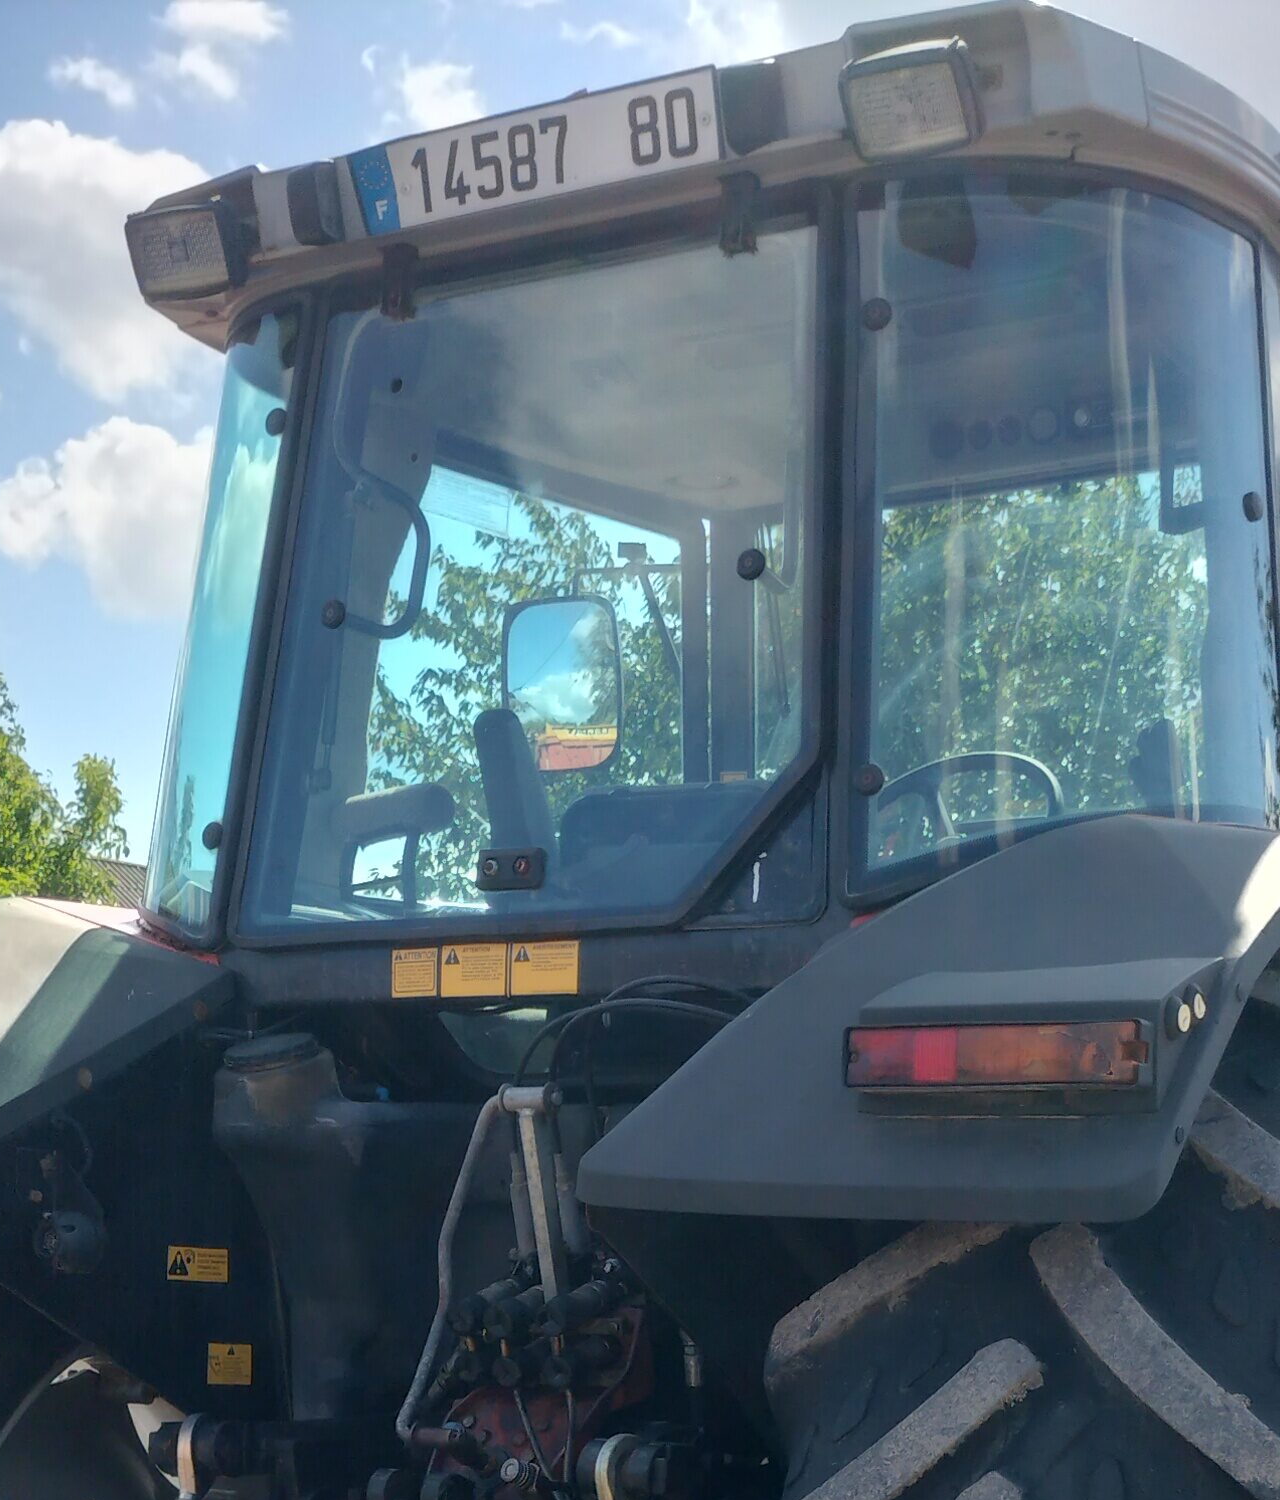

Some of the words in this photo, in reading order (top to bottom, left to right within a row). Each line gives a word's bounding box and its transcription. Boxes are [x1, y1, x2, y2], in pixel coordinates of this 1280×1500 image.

[410, 114, 569, 213] 14587
[627, 86, 700, 166] 80
[375, 199, 388, 221] F
[403, 950, 436, 960] ATTENTION
